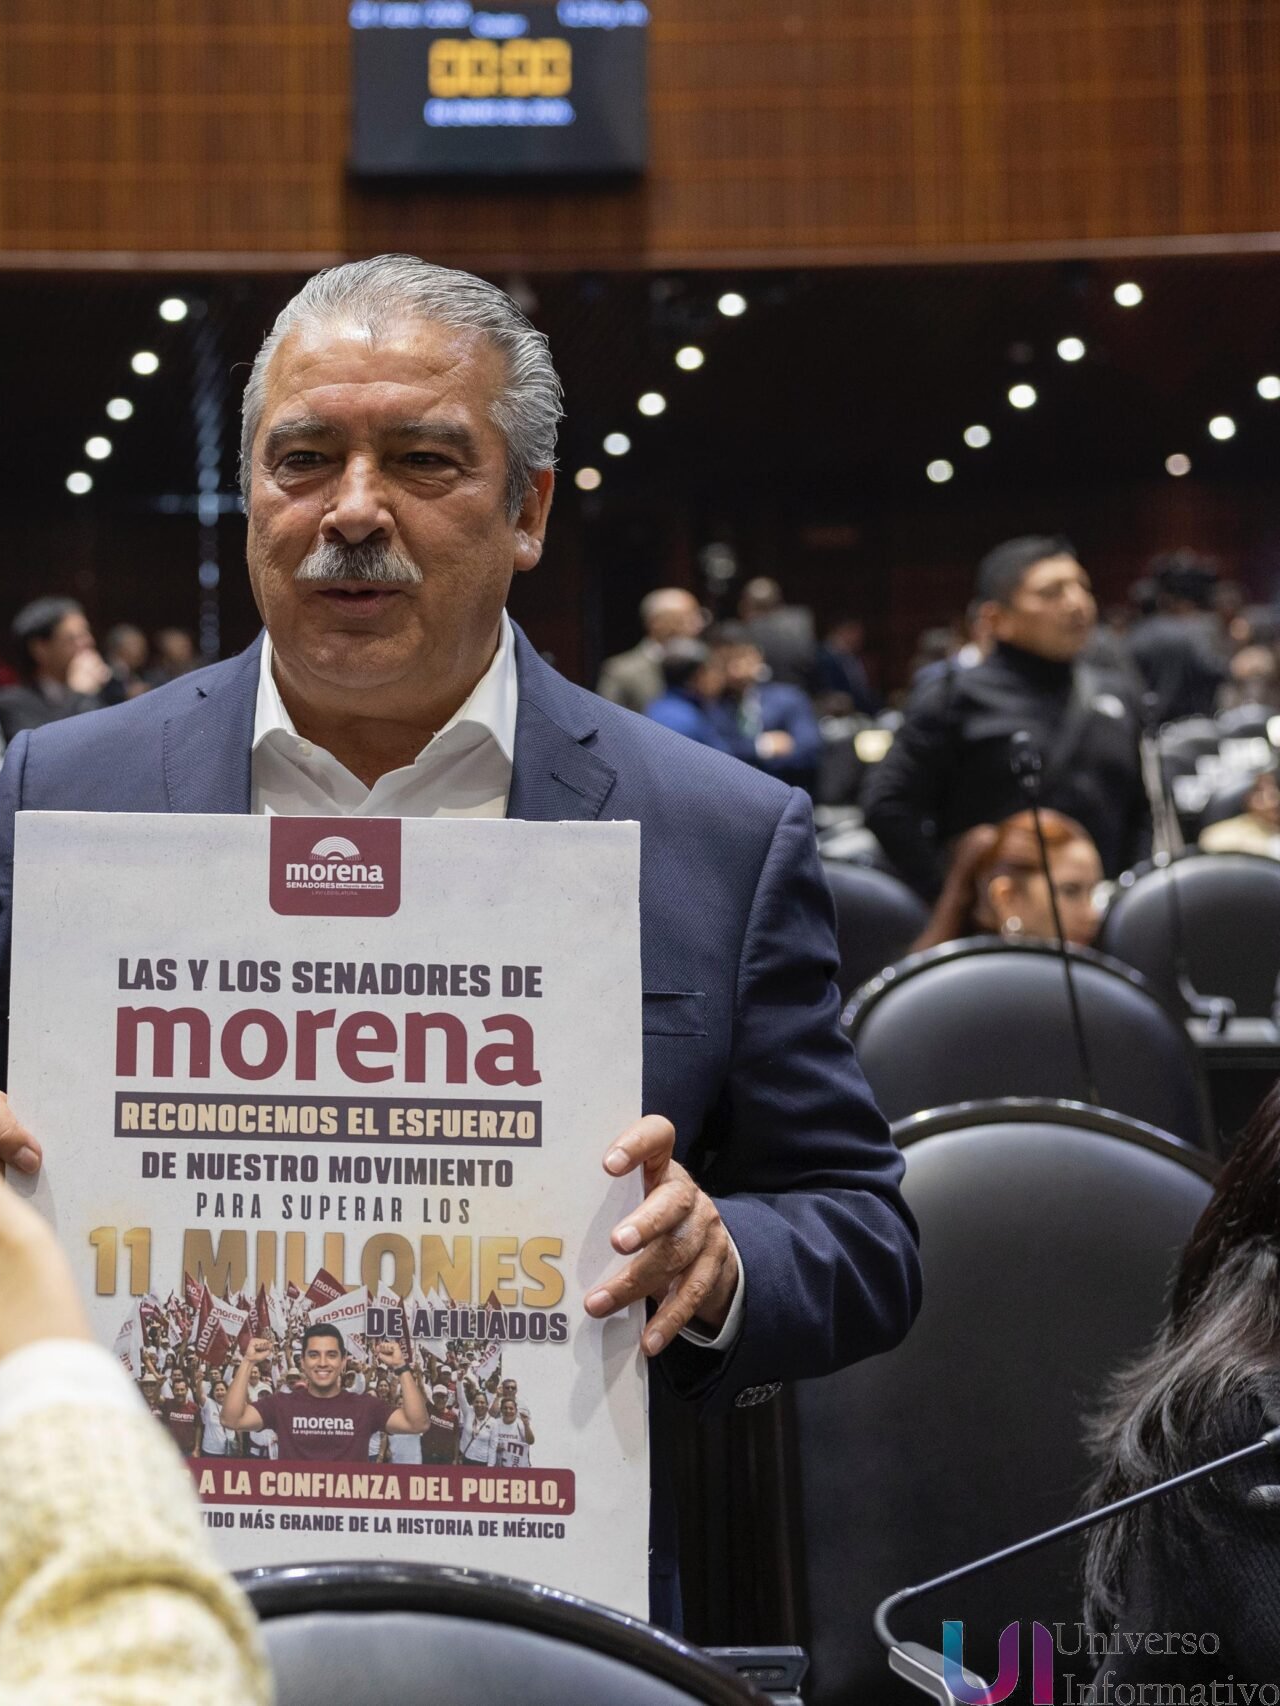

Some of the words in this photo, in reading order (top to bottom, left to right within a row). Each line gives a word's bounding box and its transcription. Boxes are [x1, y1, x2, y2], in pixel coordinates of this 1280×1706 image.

[285, 863, 384, 882] morena
[285, 881, 336, 889] SENADORES
[118, 957, 177, 991] LAS
[187, 959, 209, 992] Y
[219, 960, 282, 994] LOS
[291, 960, 490, 998] SENADORES
[501, 965, 543, 998] DE
[115, 1005, 543, 1087] morena
[121, 1102, 338, 1136] RECONOCEMOS
[347, 1109, 380, 1136] EL
[389, 1110, 536, 1140] ESFUERZO
[141, 1151, 177, 1179] DE
[187, 1153, 319, 1183] NUESTRO
[328, 1156, 513, 1188] MOVIMIENTO
[196, 1192, 262, 1219] PARA
[281, 1194, 402, 1222] SUPERAR
[423, 1198, 470, 1225] LOS
[89, 1226, 151, 1296] 11
[182, 1228, 565, 1307] MILLONES
[366, 1307, 404, 1338] DE
[412, 1307, 569, 1342] AFILIADOS
[293, 1416, 355, 1430] morena
[199, 1469, 216, 1494] A
[223, 1470, 252, 1496] LA
[259, 1471, 401, 1500] CONFIANZA
[409, 1476, 454, 1502] DEL
[462, 1477, 566, 1509] PUEBLO,
[239, 1508, 275, 1530] MÁS
[280, 1513, 344, 1532] GRANDE
[348, 1515, 369, 1533] DE
[374, 1516, 392, 1534] LA
[397, 1517, 473, 1537] HISTORIA
[478, 1520, 498, 1537] DE
[503, 1517, 565, 1540] MÉXICO
